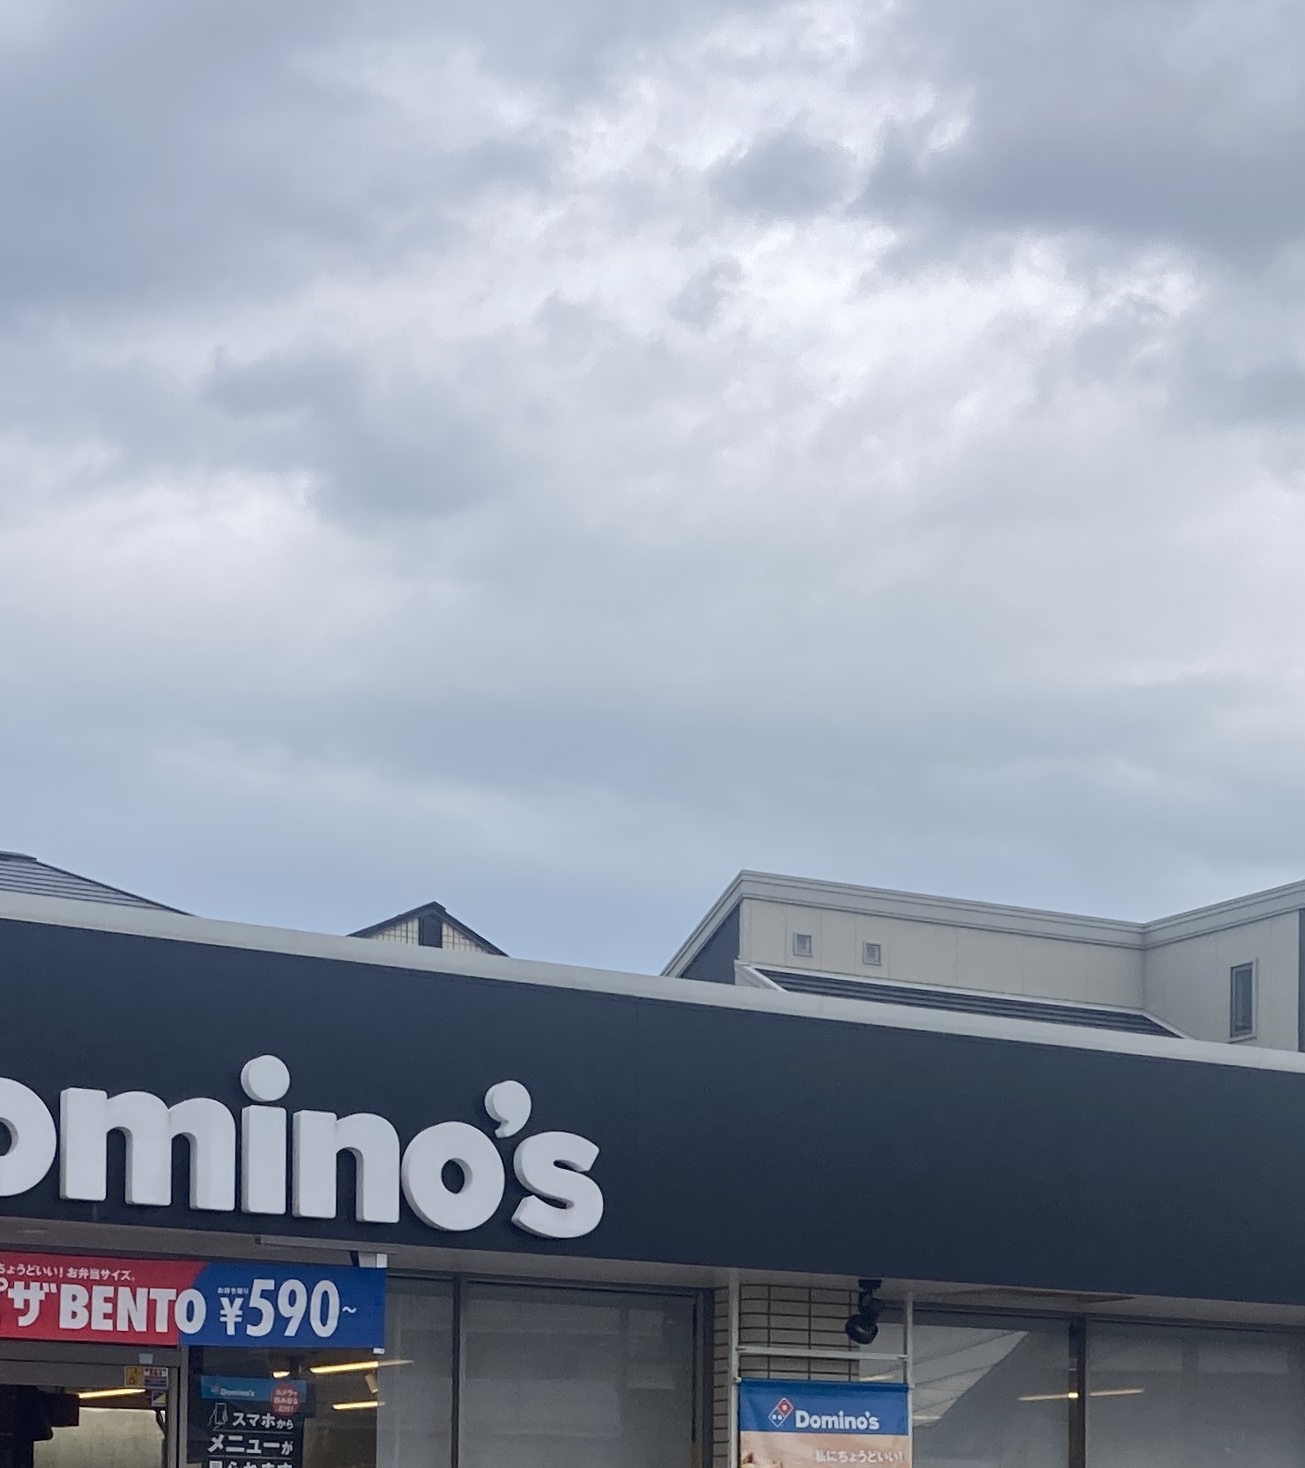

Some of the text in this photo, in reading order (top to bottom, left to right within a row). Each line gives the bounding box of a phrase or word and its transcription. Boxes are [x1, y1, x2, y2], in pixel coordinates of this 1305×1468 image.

[232, 1411, 294, 1431] スマホから
[795, 1410, 880, 1431] Domino's
[207, 1433, 294, 1456] メニューが
